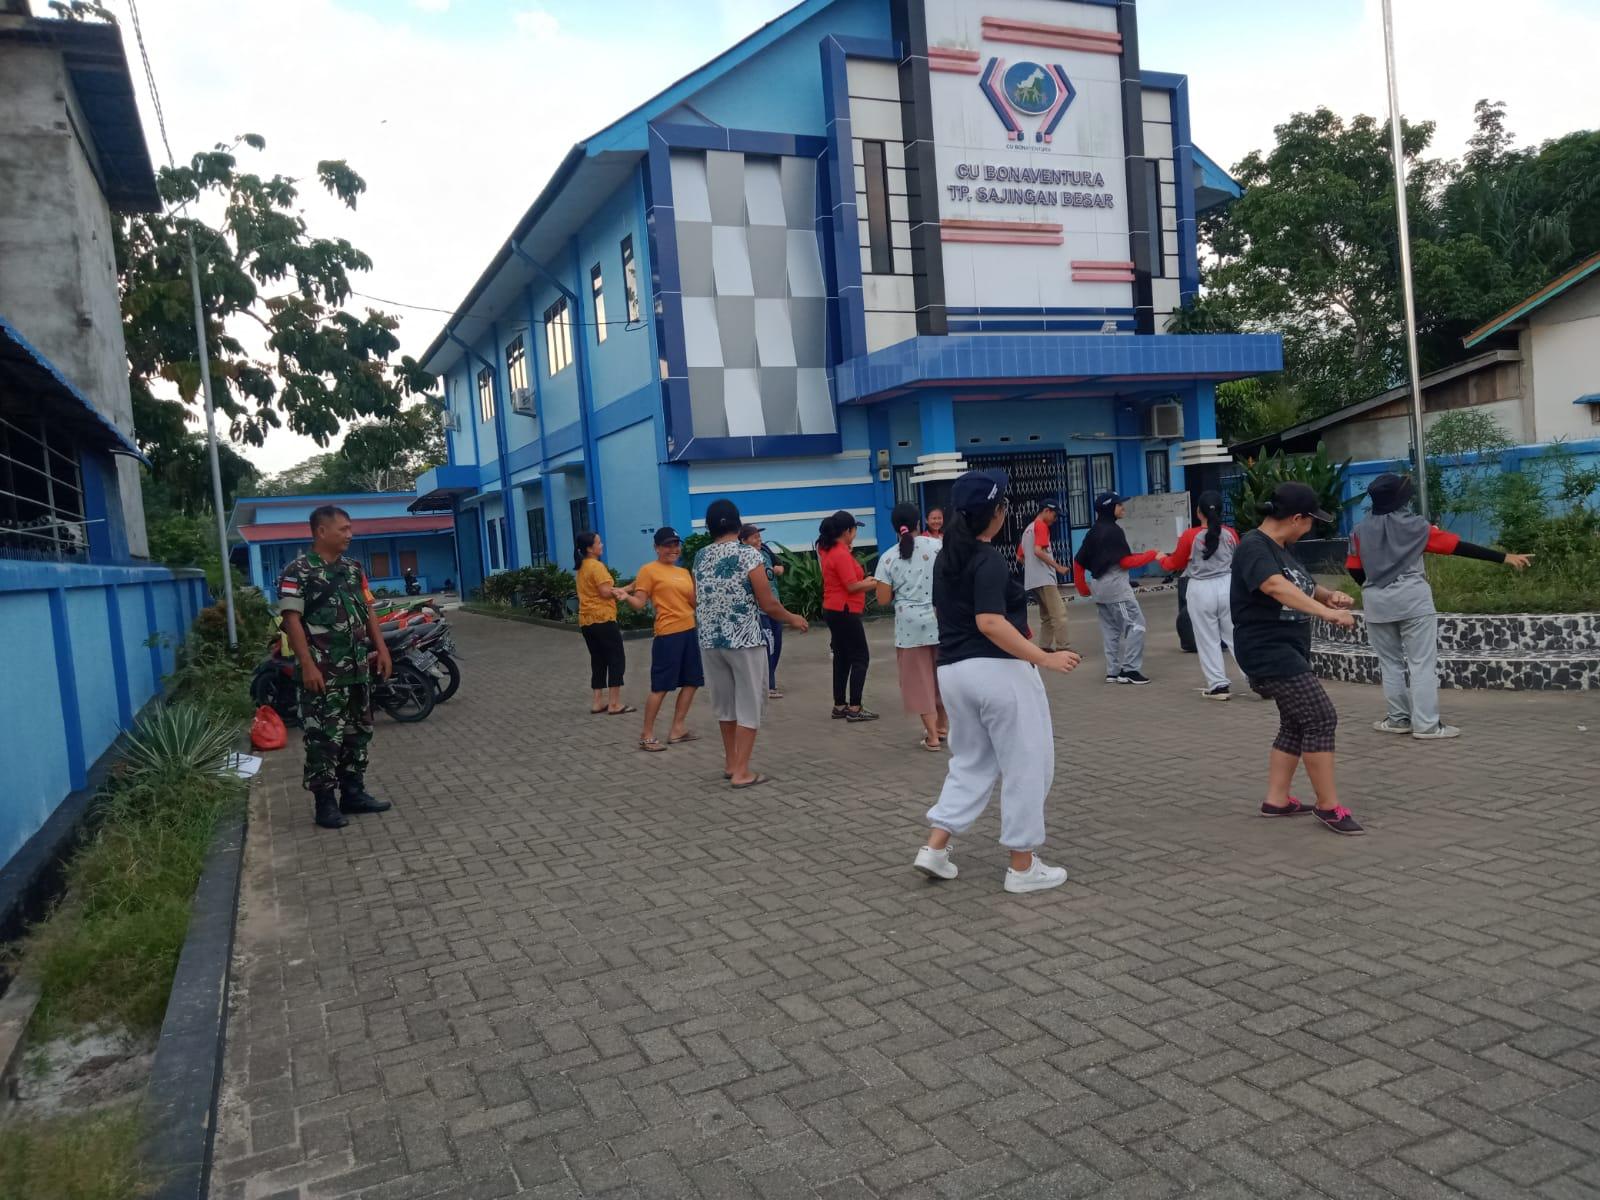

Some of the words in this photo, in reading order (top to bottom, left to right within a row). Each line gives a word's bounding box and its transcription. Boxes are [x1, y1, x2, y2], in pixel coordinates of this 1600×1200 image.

[955, 163, 980, 180] CU
[983, 165, 1105, 187] BONAVENTURA
[947, 185, 973, 201] TP.
[975, 186, 1058, 206] SAJINGAN
[1061, 191, 1115, 209] BESAR
